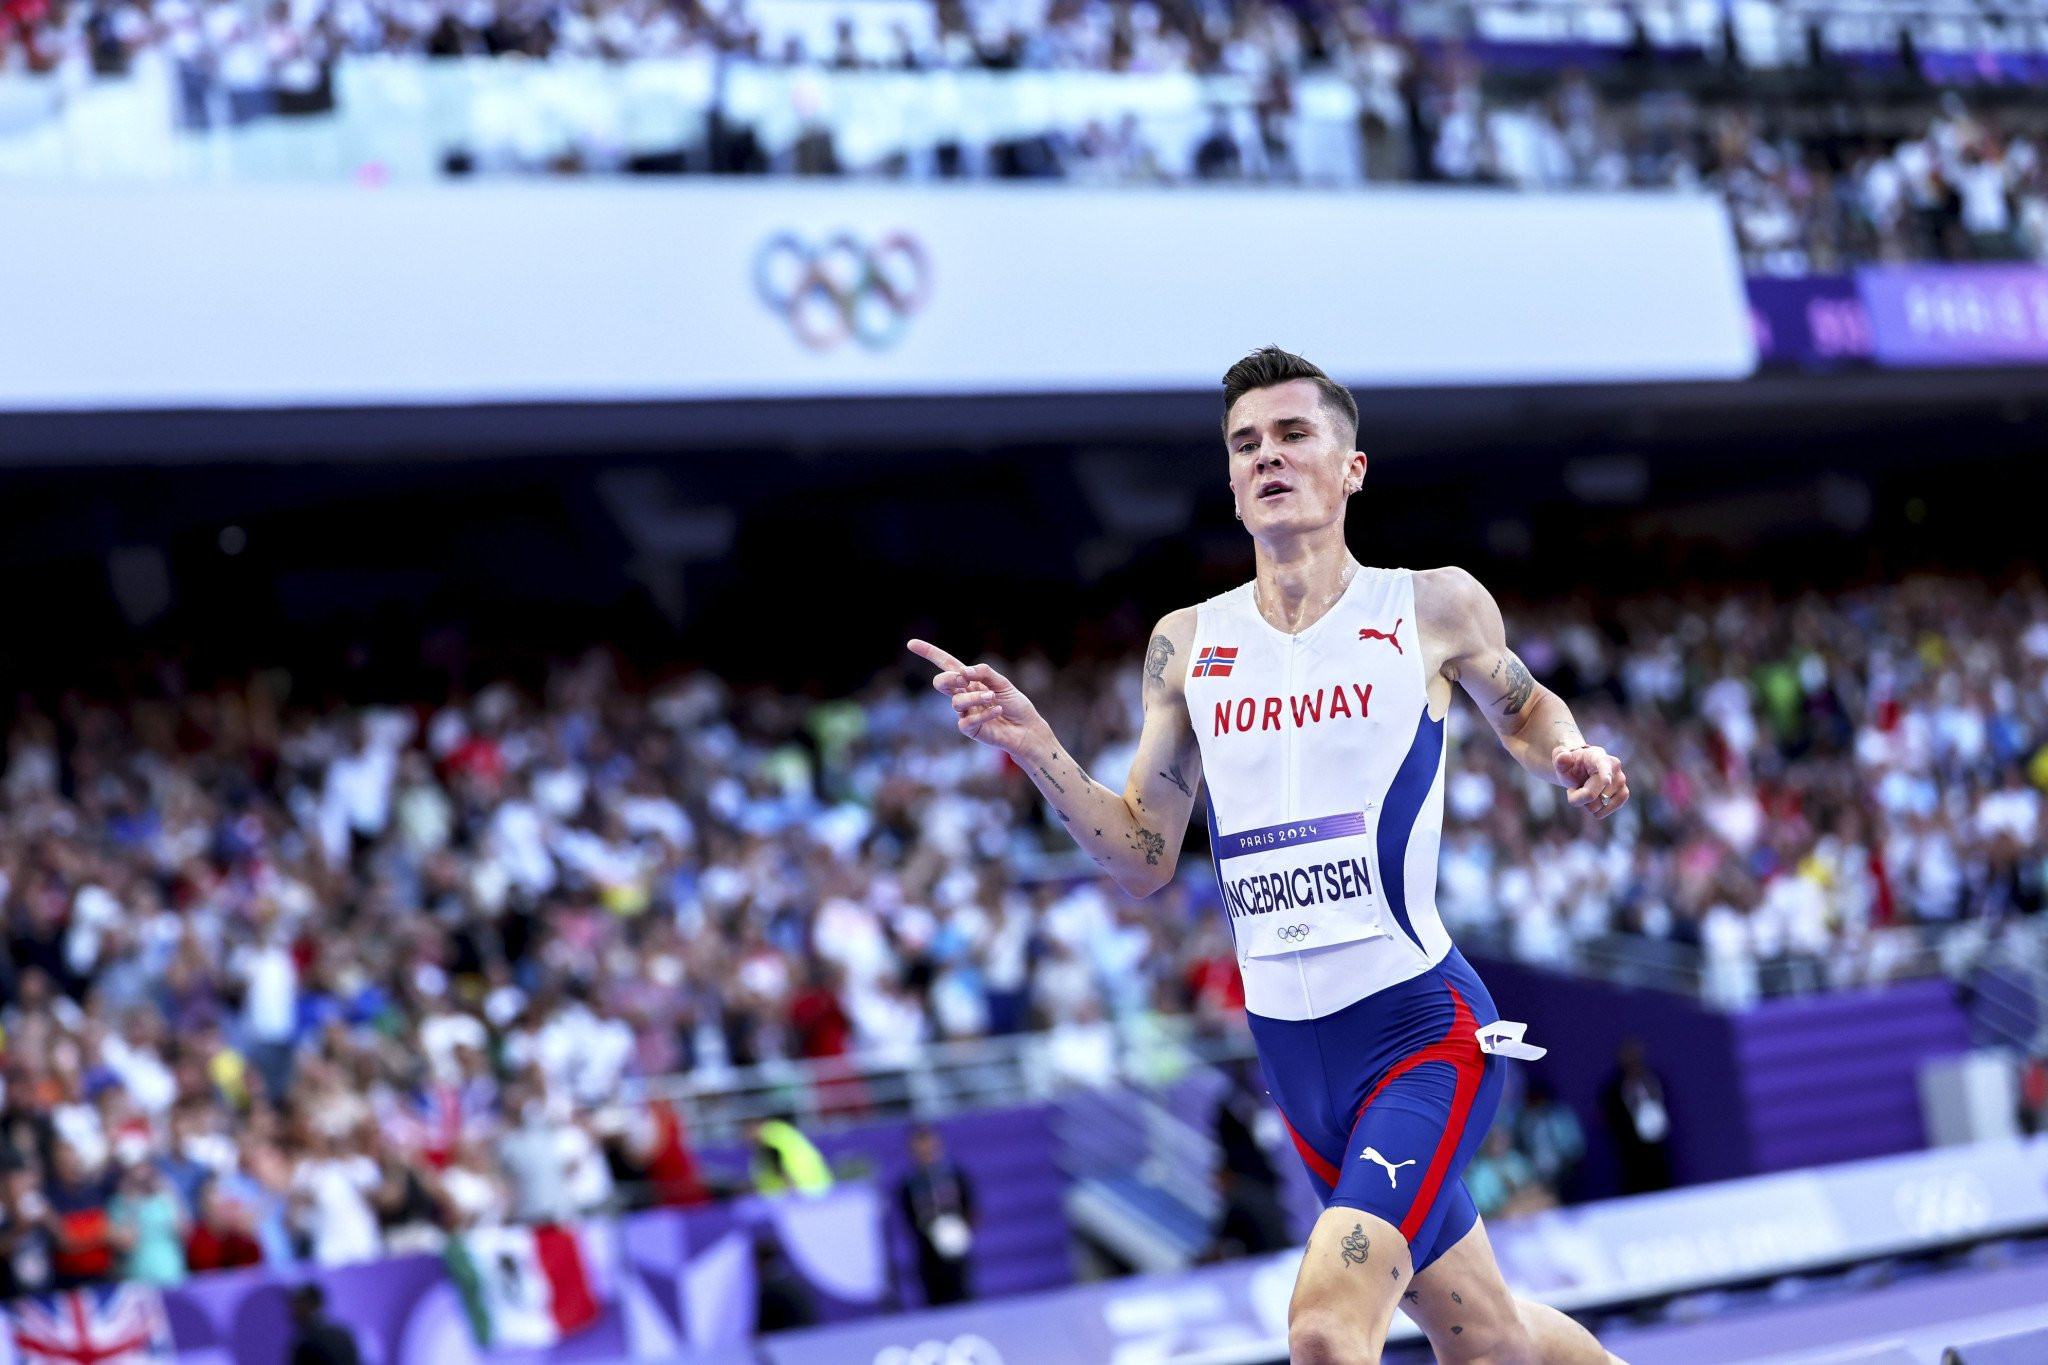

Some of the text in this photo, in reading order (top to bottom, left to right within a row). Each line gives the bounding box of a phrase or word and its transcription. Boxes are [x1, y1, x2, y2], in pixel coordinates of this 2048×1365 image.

[1214, 683, 1373, 737] NORWAY
[1278, 825, 1317, 842] 2024
[1224, 856, 1373, 919] INGEBRIGTSEN
